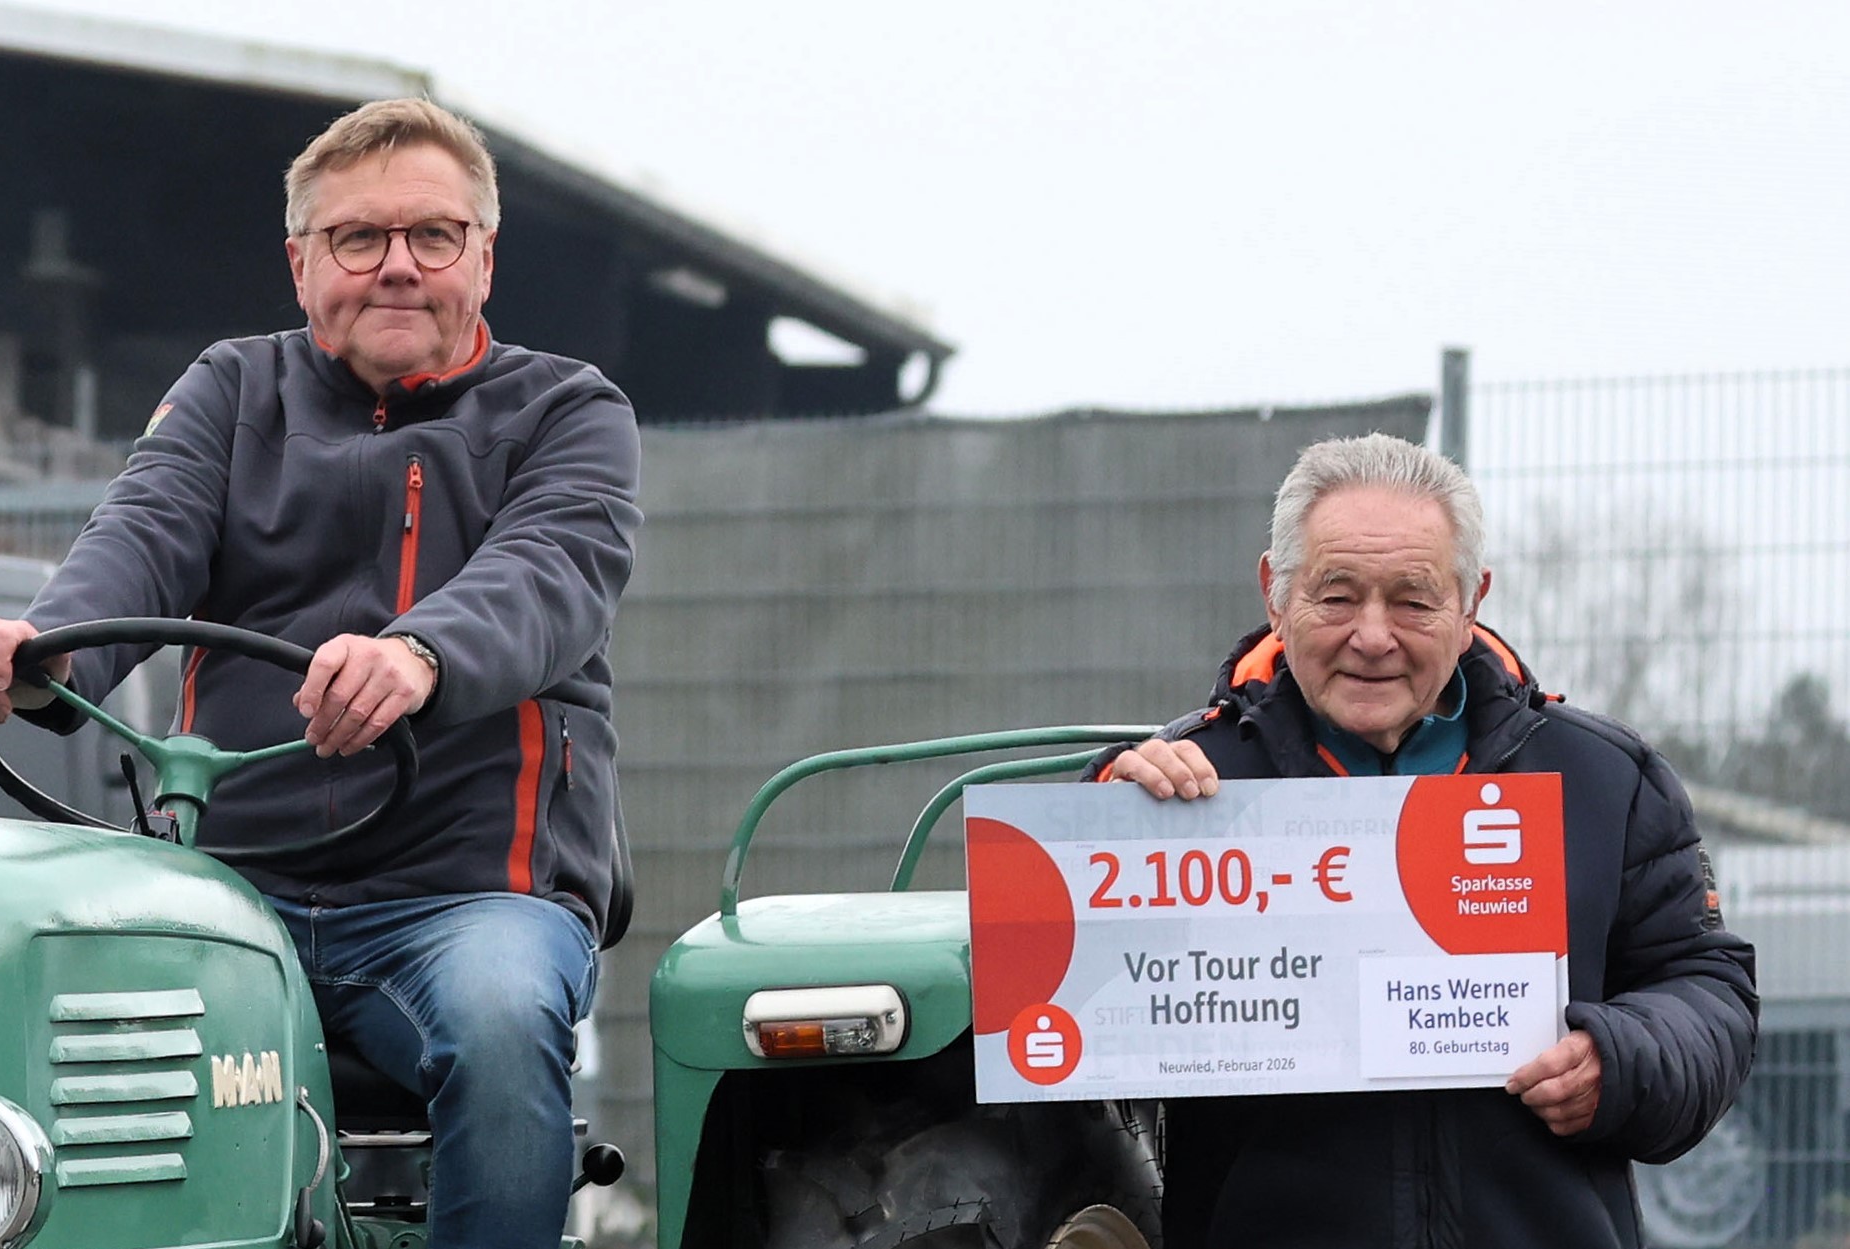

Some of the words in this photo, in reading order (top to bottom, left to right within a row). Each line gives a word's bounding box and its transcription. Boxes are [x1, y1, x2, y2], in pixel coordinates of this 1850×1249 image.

[1312, 846, 1353, 903] €
[1450, 873, 1534, 899] Sparkasse
[1457, 896, 1529, 916] Neuwied
[1123, 951, 1181, 984] Vor
[1186, 950, 1259, 982] Tour
[1268, 945, 1324, 980] der
[1386, 979, 1443, 1003] Hans
[1446, 977, 1530, 1001] Werner
[1149, 989, 1301, 1031] Hoffnung
[1407, 1004, 1510, 1031] Kambeck
[1408, 1040, 1432, 1056] 80.
[1433, 1039, 1510, 1058] Geburtstag
[1158, 1059, 1216, 1077] Neuwied,
[1217, 1058, 1265, 1074] Februar
[1266, 1057, 1296, 1073] 2026
